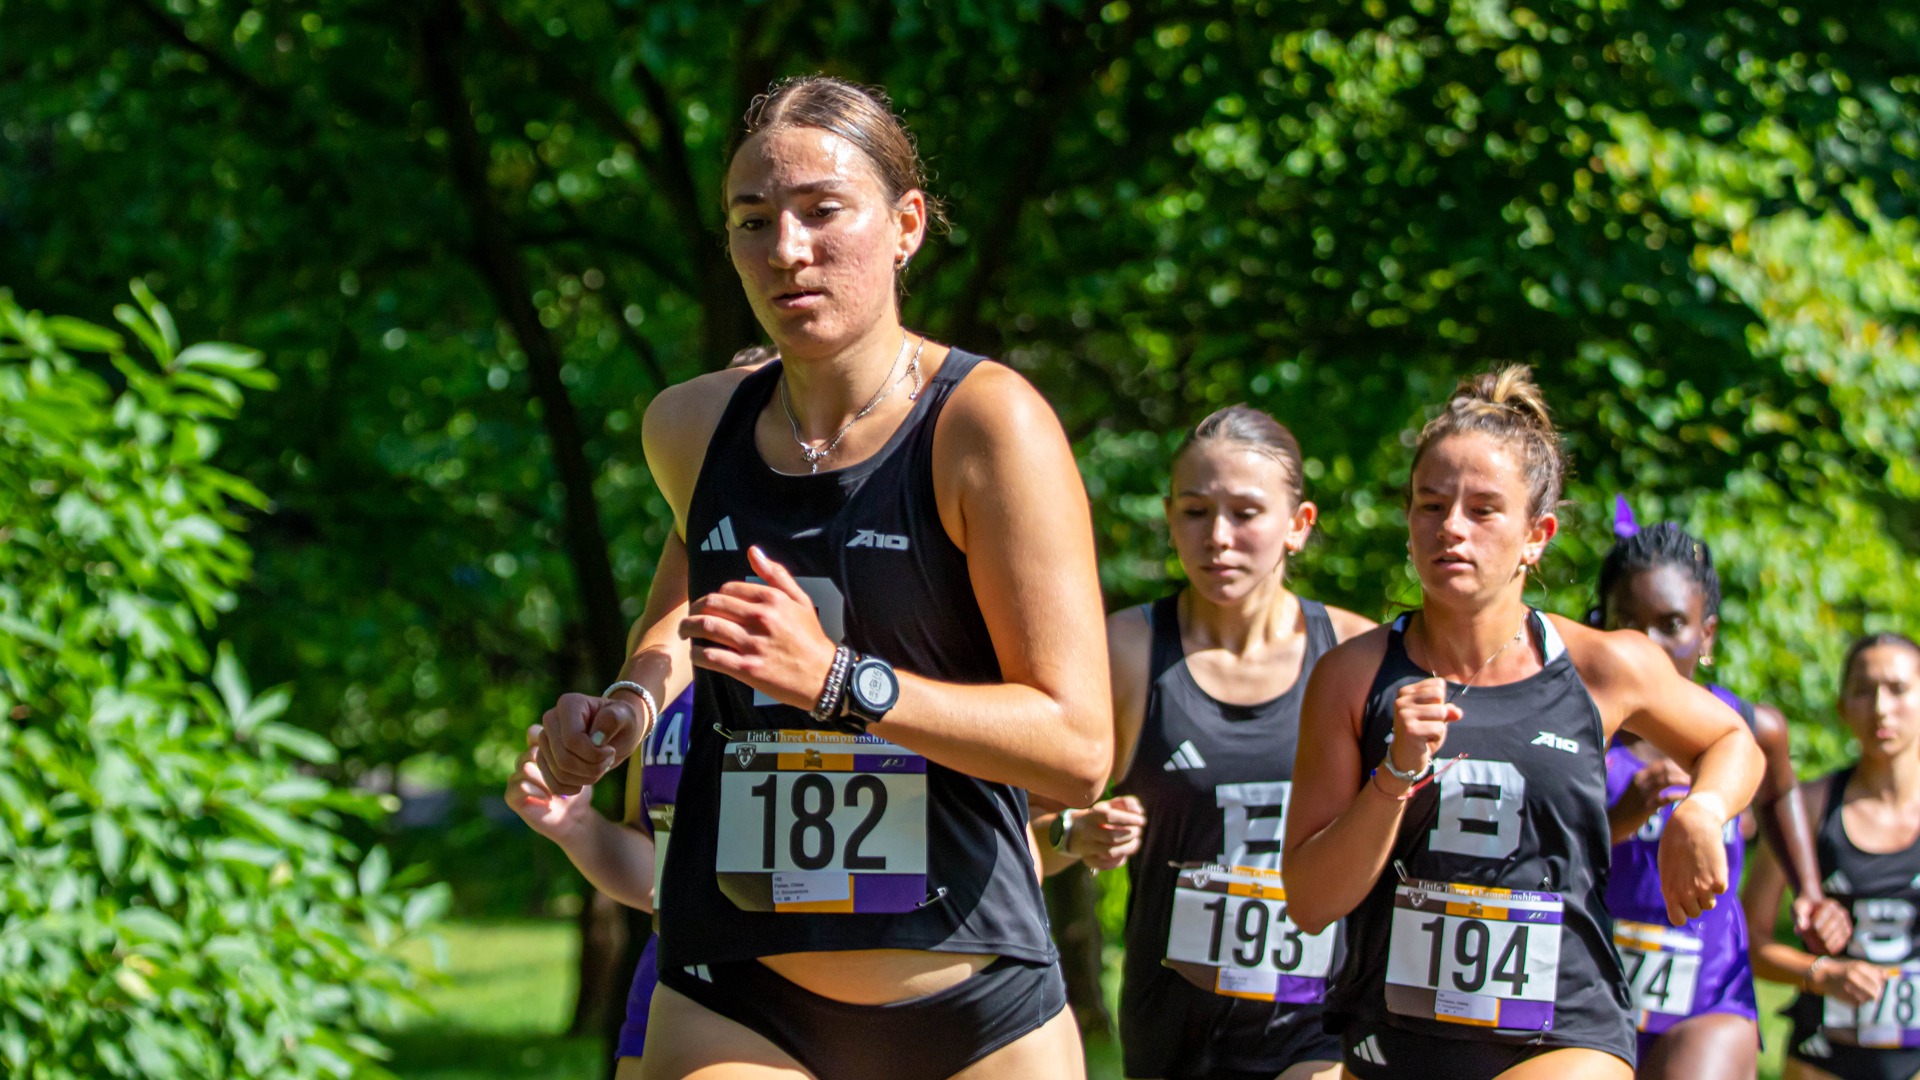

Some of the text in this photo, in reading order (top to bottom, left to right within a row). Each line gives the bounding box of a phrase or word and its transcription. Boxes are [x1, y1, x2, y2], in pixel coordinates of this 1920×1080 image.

[846, 529, 909, 550] A10
[747, 731, 771, 743] Little
[773, 731, 803, 743] Three
[1531, 731, 1580, 754] A10
[752, 773, 888, 871] 182
[1429, 757, 1526, 860] B
[1418, 880, 1541, 902] Little Three Championships
[1204, 897, 1303, 971] 193
[1421, 916, 1529, 996] 194
[1847, 898, 1917, 962] B
